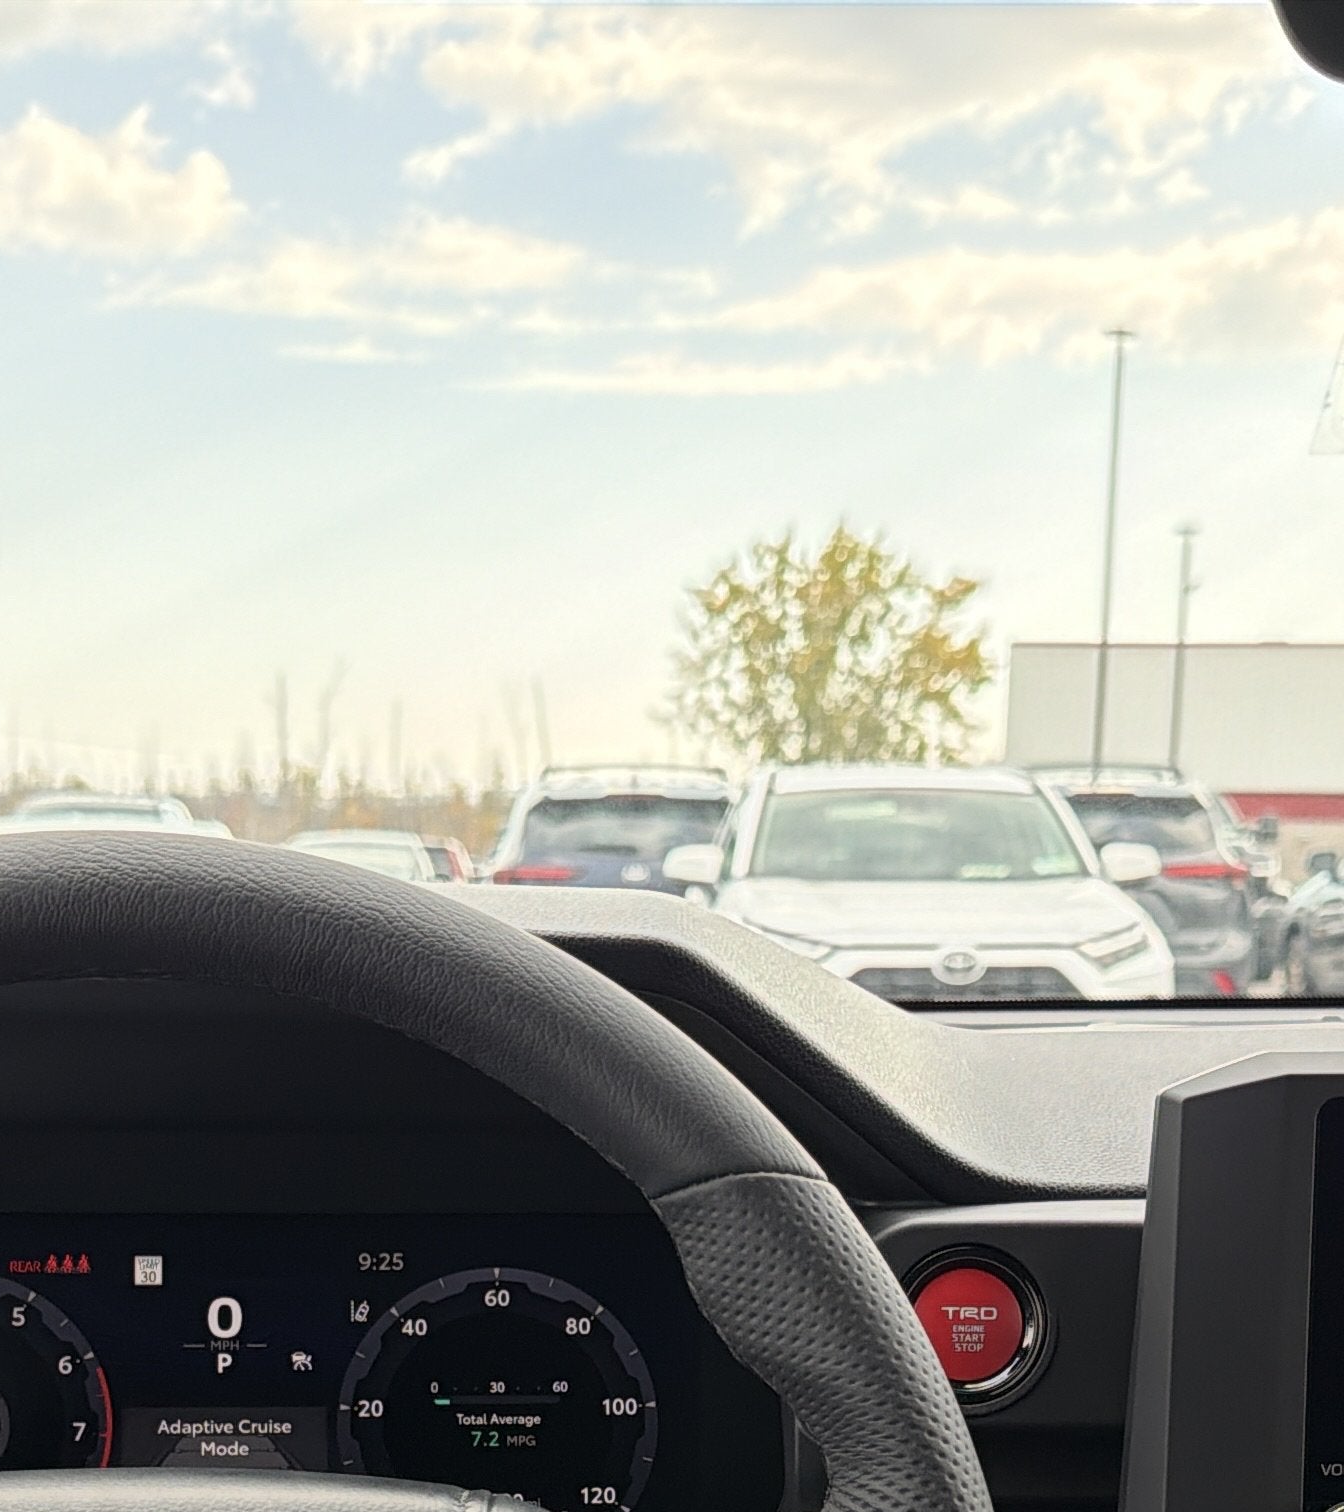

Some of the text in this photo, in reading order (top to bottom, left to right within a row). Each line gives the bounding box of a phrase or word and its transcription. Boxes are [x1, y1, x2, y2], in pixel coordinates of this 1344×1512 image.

[9, 1260, 41, 1273] REAR
[358, 1252, 405, 1272] 9:25
[140, 1270, 157, 1283] 30
[484, 1288, 511, 1308] 60
[11, 1306, 26, 1327] 5
[207, 1297, 243, 1339] 0
[940, 1306, 998, 1321] TRD
[401, 1318, 428, 1337] 40
[565, 1318, 591, 1337] 80
[952, 1324, 985, 1333] ENGINE
[210, 1340, 240, 1351] MPH
[951, 1333, 986, 1343] START
[954, 1343, 984, 1352] STOP
[58, 1356, 73, 1375] 6
[217, 1353, 233, 1374] P
[430, 1382, 440, 1394] 0
[489, 1382, 506, 1394] 30
[552, 1381, 569, 1394] 60
[358, 1400, 384, 1418] 20
[601, 1398, 638, 1416] 100
[157, 1419, 292, 1437] Adaptive Cruise
[456, 1412, 542, 1428] Total Average
[72, 1423, 86, 1442] 7
[471, 1431, 537, 1448] 7.2 MPG
[201, 1441, 250, 1456] Mode
[580, 1486, 617, 1505] 120
